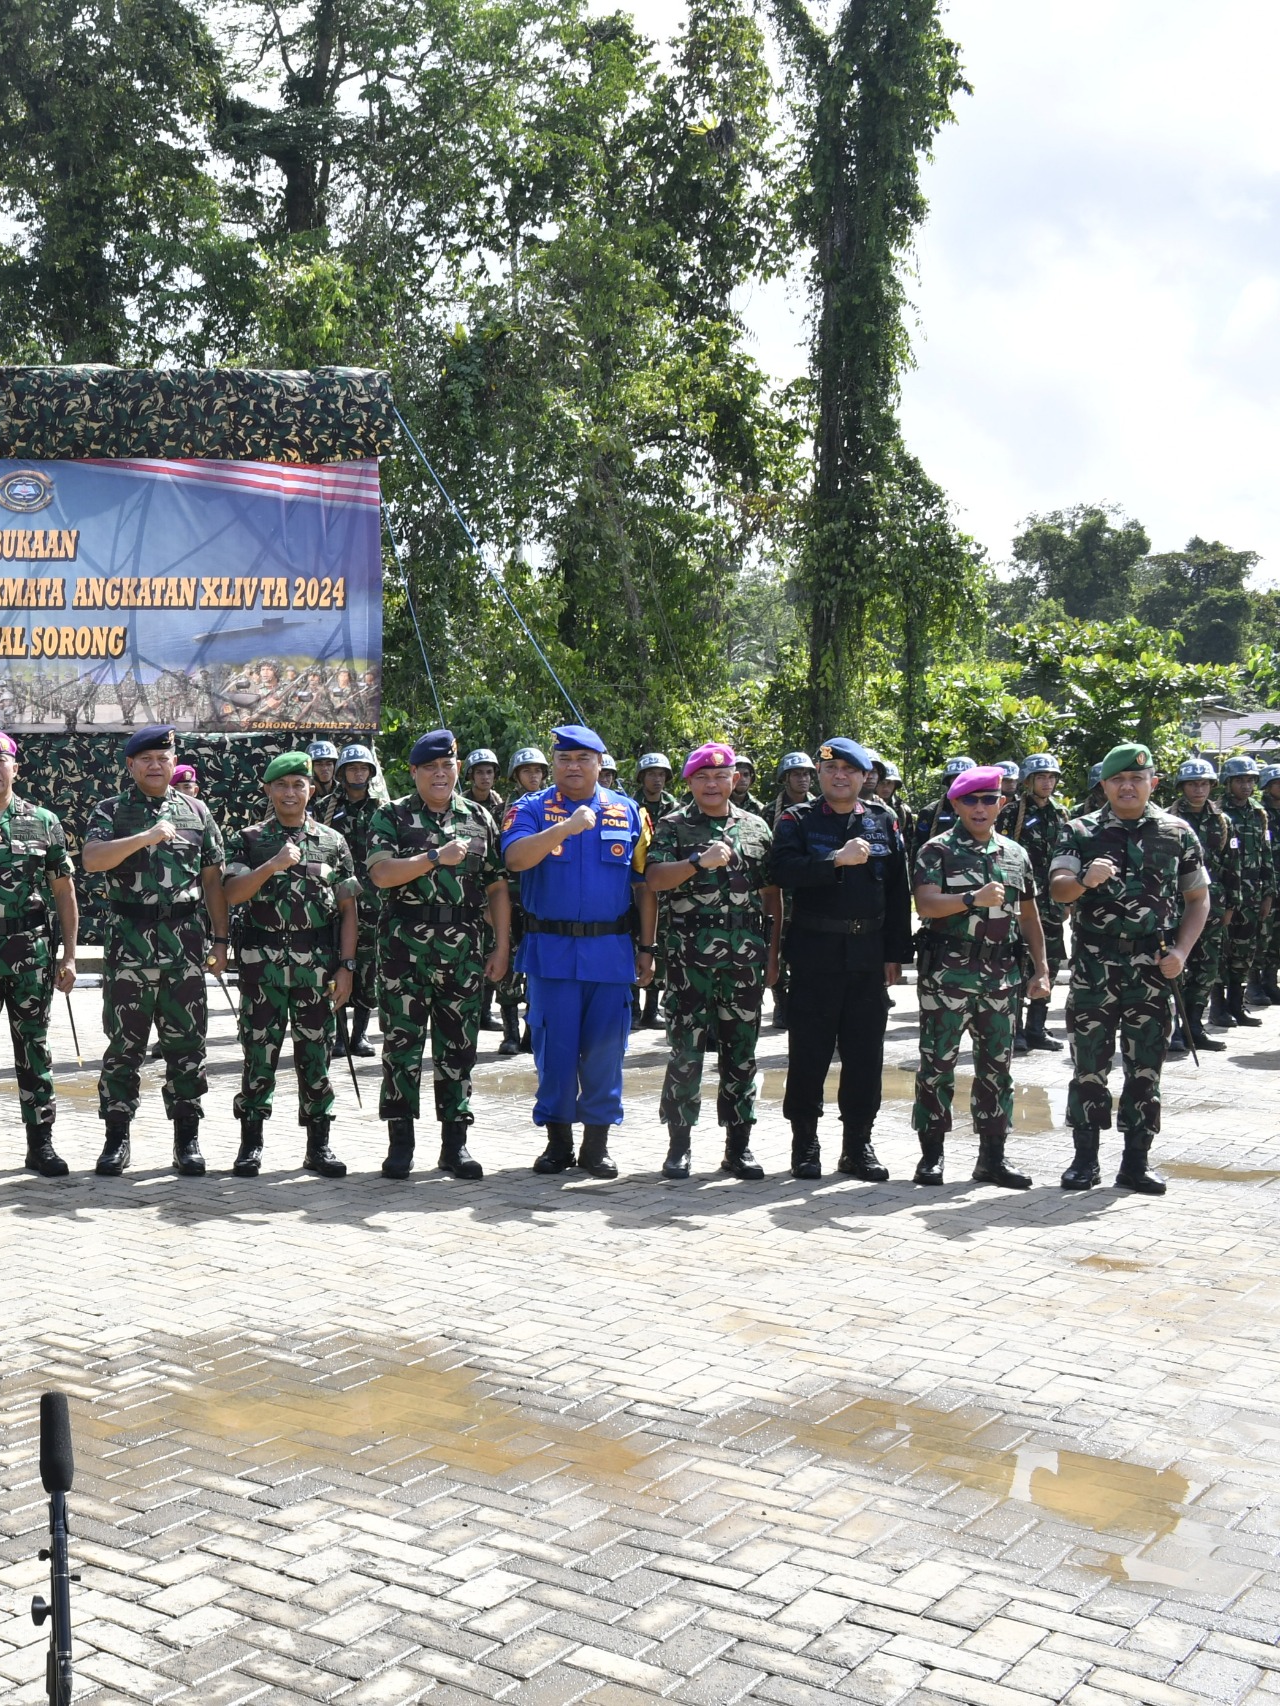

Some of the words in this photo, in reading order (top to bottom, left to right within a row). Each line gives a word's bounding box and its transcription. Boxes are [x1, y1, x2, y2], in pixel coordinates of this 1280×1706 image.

[73, 576, 199, 610] ANGKATAN
[200, 577, 260, 609] XLIV
[262, 577, 290, 609] TA
[293, 576, 347, 609] 2024
[30, 625, 127, 659] SORONG
[252, 720, 298, 731] SORONG,
[298, 720, 312, 730] 28
[313, 721, 352, 731] MARET
[353, 721, 378, 731] 2024
[544, 813, 568, 823] BUD
[601, 818, 630, 829] POLRI
